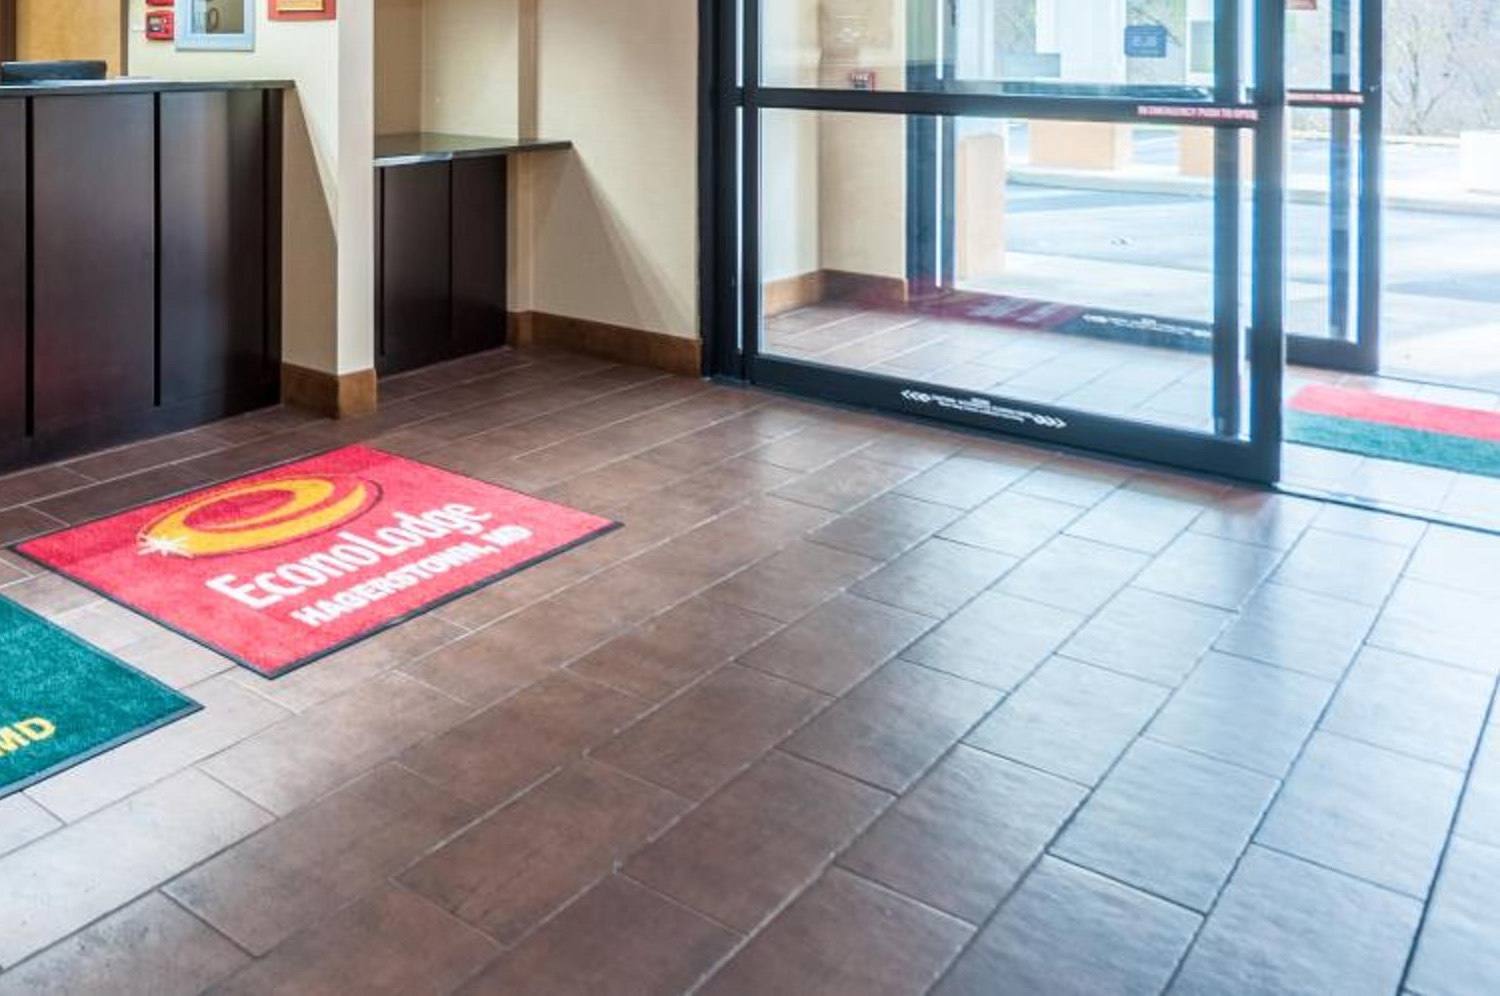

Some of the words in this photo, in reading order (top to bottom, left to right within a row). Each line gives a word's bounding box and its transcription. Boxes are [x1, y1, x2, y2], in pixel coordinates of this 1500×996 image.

[206, 502, 492, 609] EconoLodge
[290, 541, 500, 626] HAGERSTOWN,
[480, 524, 533, 553] MD
